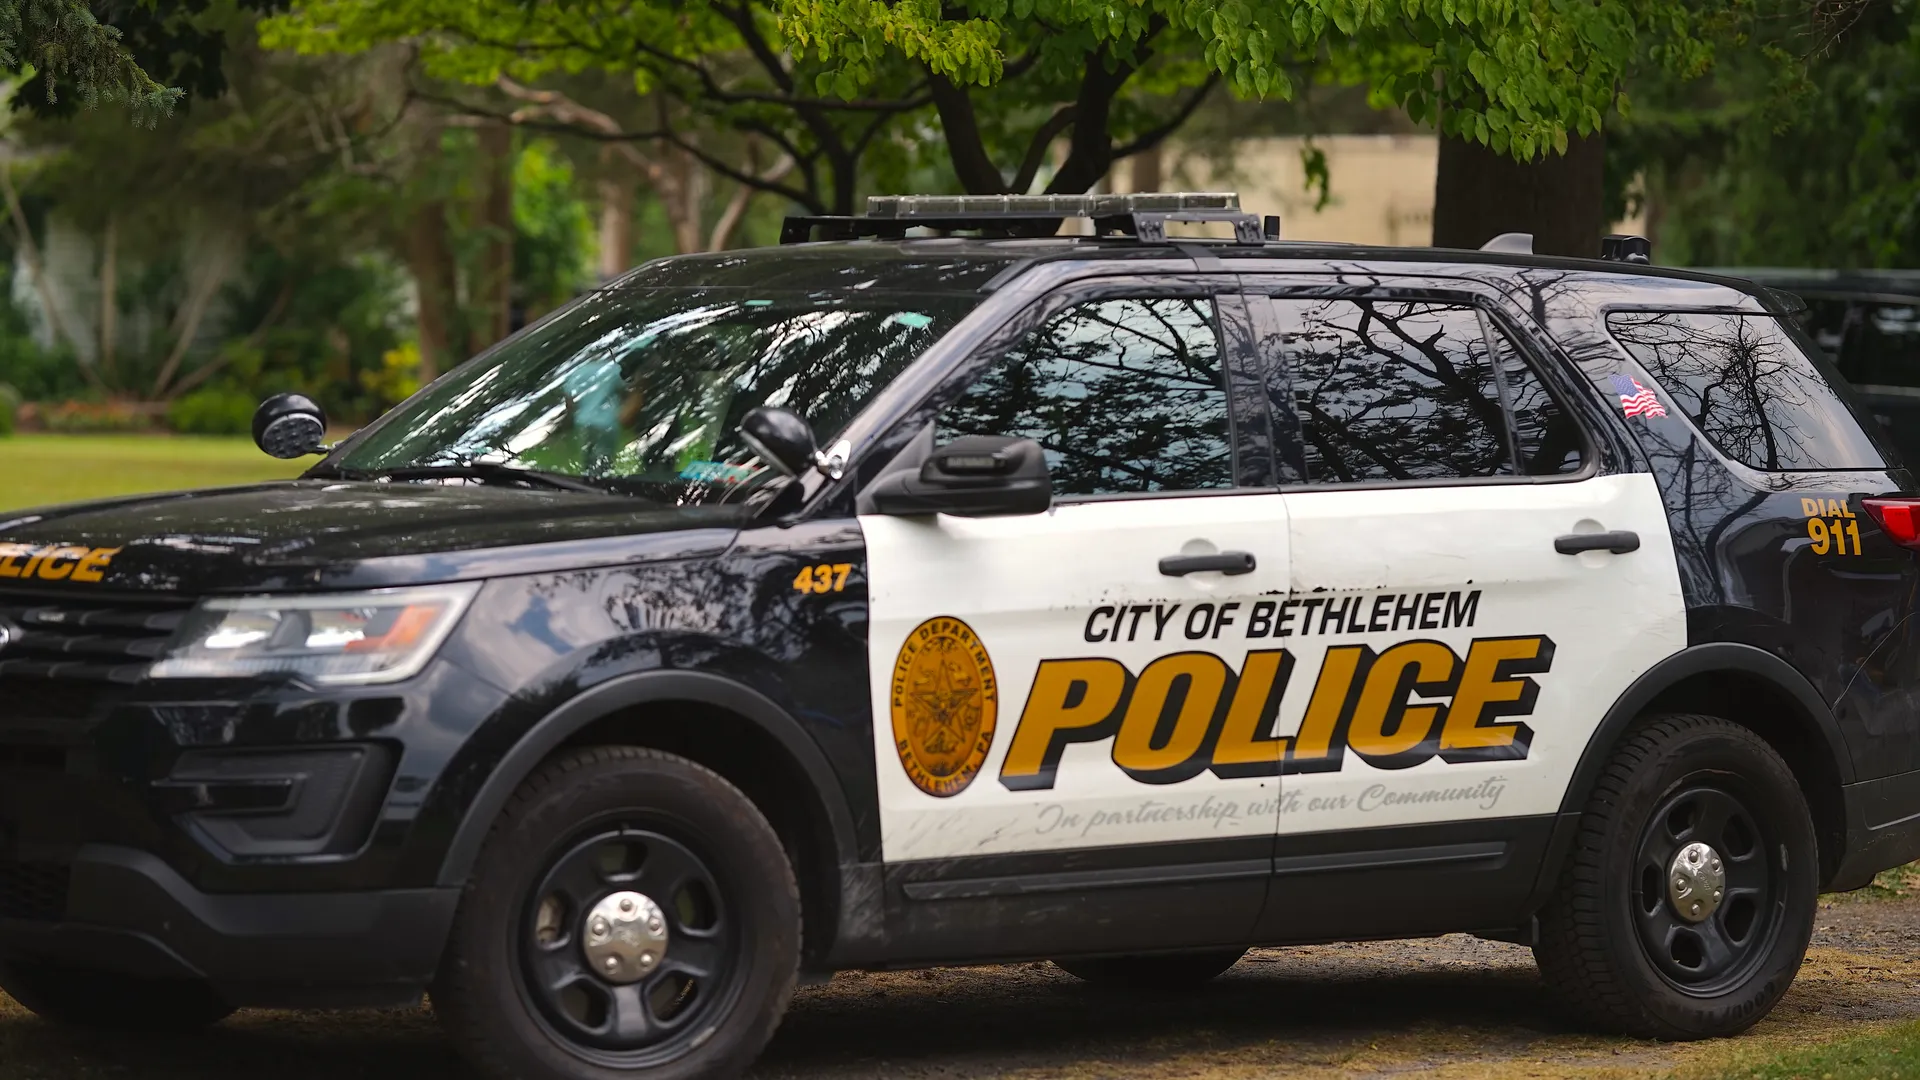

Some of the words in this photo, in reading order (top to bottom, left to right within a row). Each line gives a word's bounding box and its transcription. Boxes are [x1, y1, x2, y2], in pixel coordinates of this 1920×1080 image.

[1801, 498, 1856, 518] DIAL
[1807, 517, 1861, 555] 911
[0, 542, 124, 582] LICE
[793, 563, 852, 594] 437
[1084, 604, 1181, 643] CITY
[1184, 602, 1241, 640] OF
[1246, 590, 1481, 639] BETHLEHEM
[894, 642, 918, 707] POLICE
[919, 621, 994, 701] DEPARTMENT
[998, 634, 1556, 791] POLICE
[977, 732, 992, 755] PA
[1035, 804, 1078, 834] In
[1081, 796, 1241, 837] partnership
[1247, 788, 1303, 816] with
[1308, 793, 1350, 812] our
[1357, 776, 1508, 812] Community
